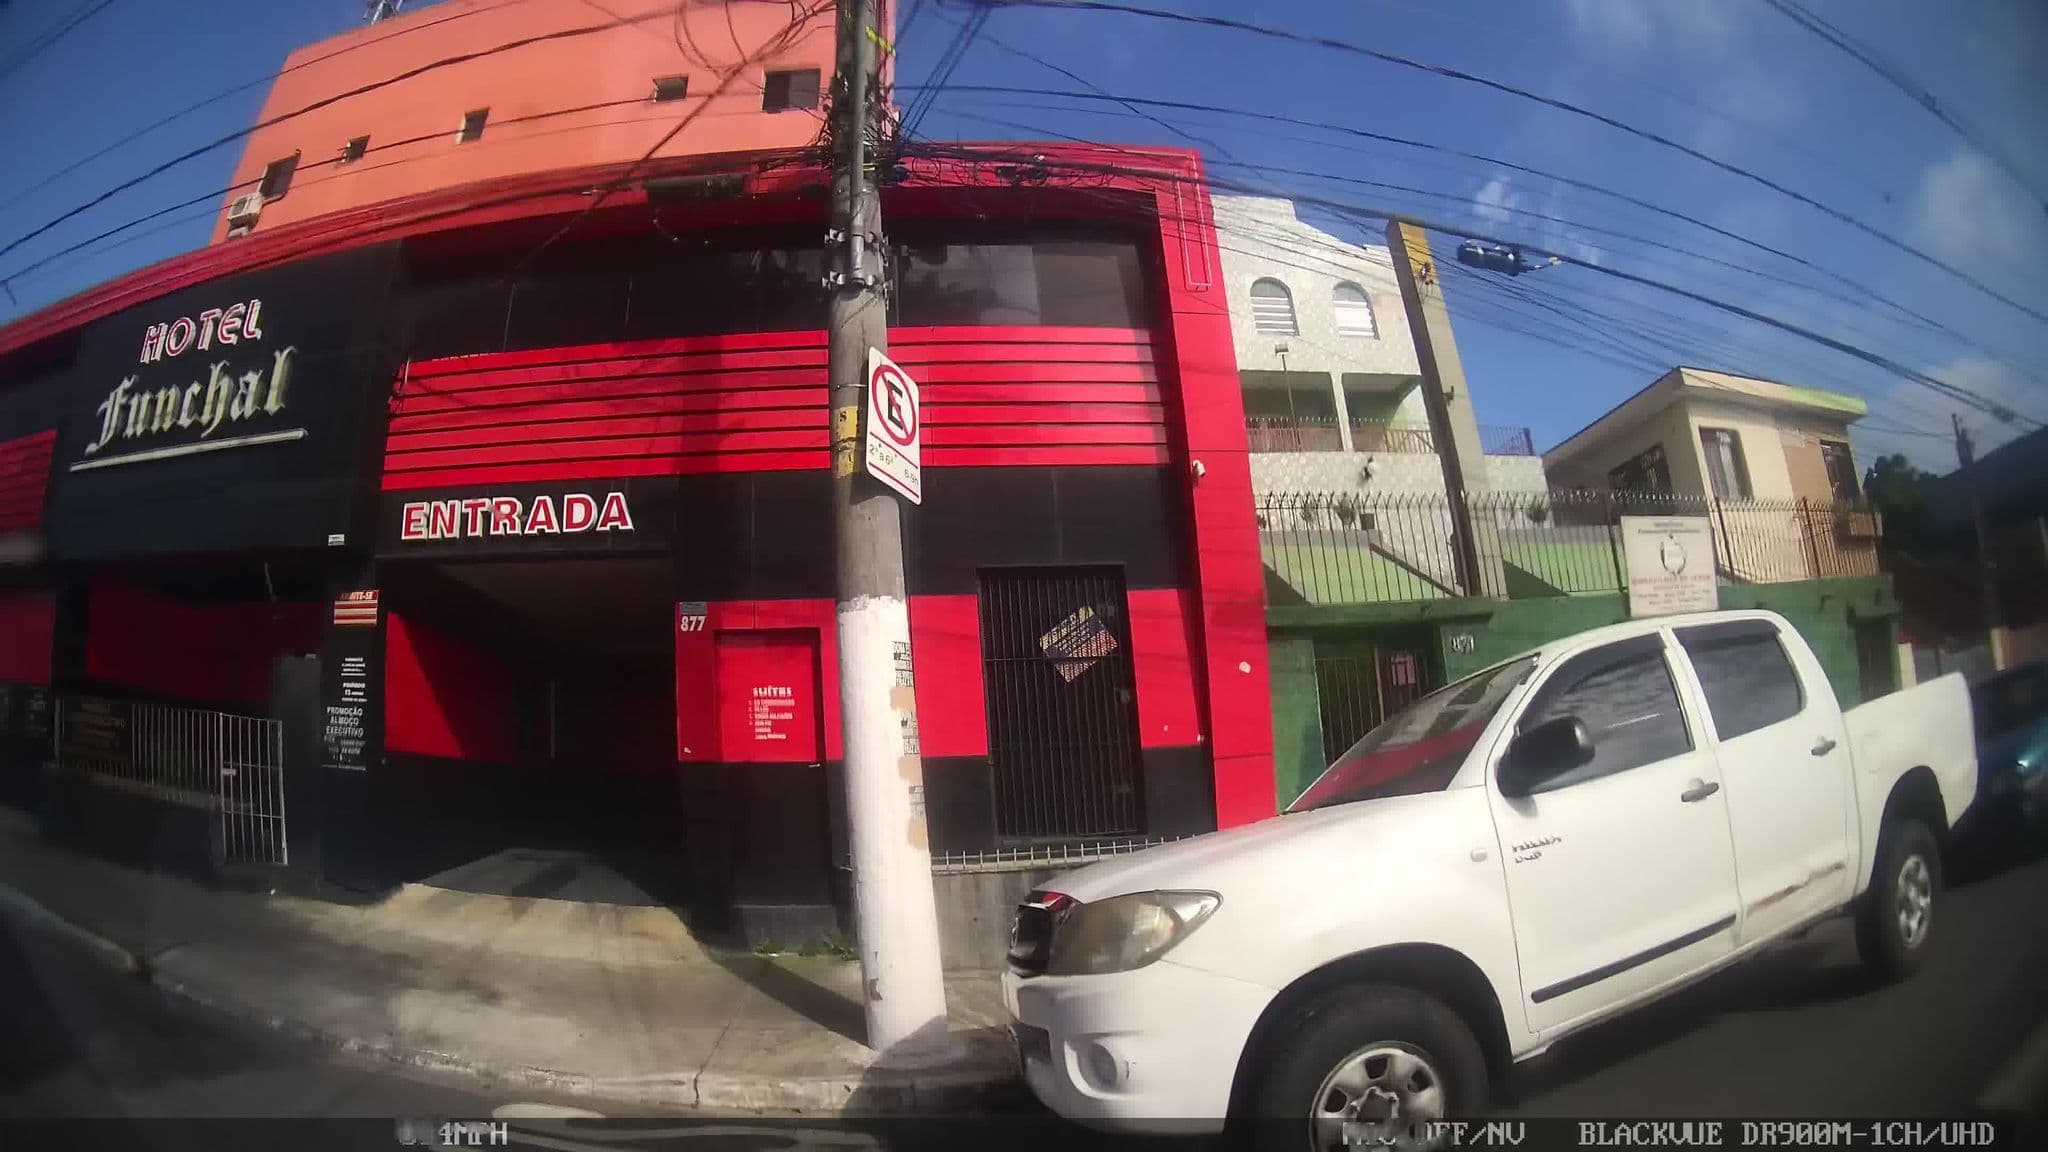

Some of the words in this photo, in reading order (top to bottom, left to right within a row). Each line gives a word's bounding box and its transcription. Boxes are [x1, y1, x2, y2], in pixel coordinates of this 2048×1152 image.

[140, 299, 262, 364] HOTEL
[85, 346, 296, 454] Funchal
[401, 492, 634, 540] ENTRADA
[680, 615, 707, 632] 877
